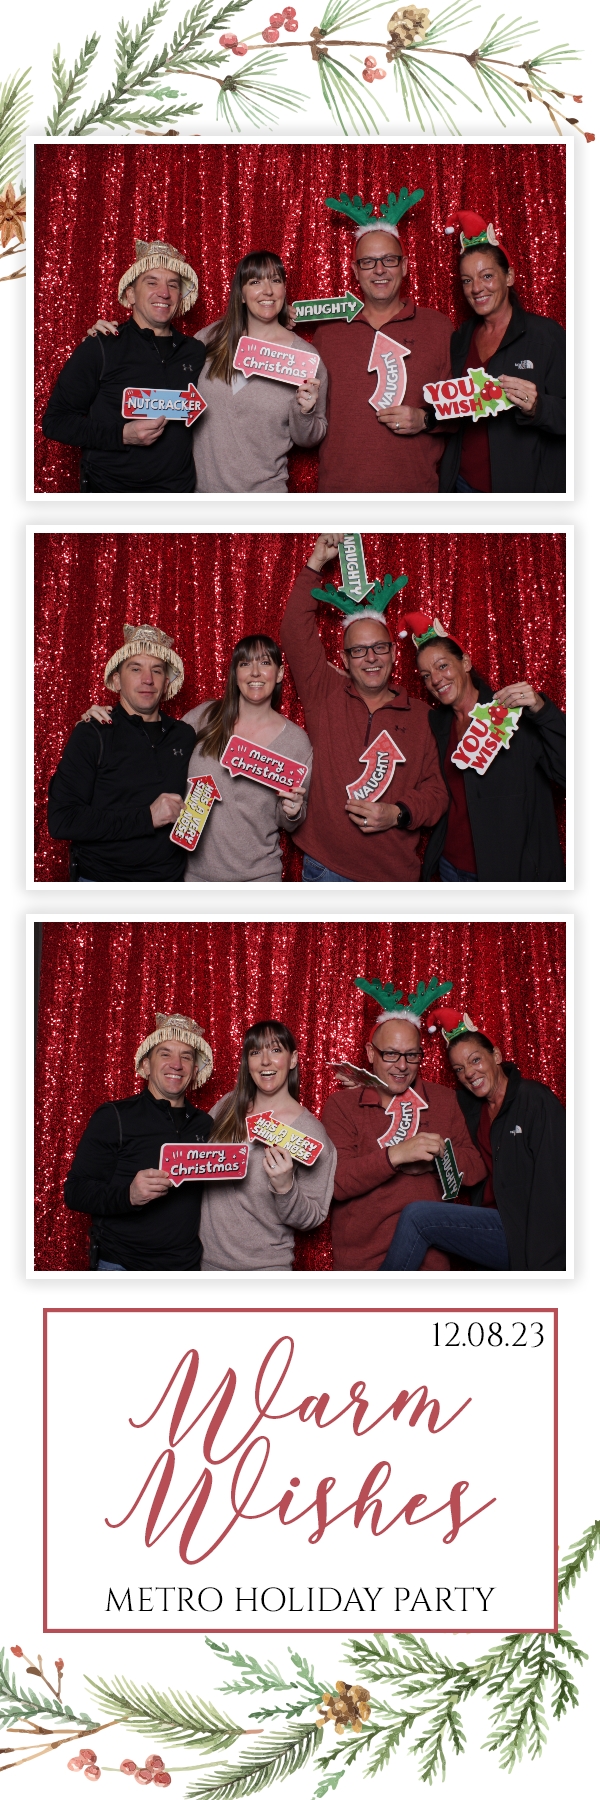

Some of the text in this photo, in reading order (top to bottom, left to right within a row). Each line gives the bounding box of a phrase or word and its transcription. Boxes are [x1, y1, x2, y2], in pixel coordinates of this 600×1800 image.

[295, 301, 357, 317] NAUGHTY
[242, 356, 308, 378] Christmas
[259, 346, 296, 366] Merry
[377, 351, 399, 410] NAUGHTY
[425, 378, 475, 402] YOU
[127, 397, 202, 412] NUTCRACKER
[435, 397, 484, 417] WISH
[343, 535, 362, 595] NAUGHTY
[452, 718, 489, 765] YOU
[470, 726, 506, 769] WISH
[230, 756, 294, 787] Christmas
[248, 749, 285, 773] Merry
[353, 751, 389, 800] NAUGHTY
[175, 780, 205, 839] SHINY NOSE
[185, 783, 215, 845] HAS A VERY
[251, 1125, 312, 1161] SHINY NOSE
[256, 1117, 318, 1152] HAS A VERY
[170, 1160, 239, 1176] Christmas
[186, 1149, 226, 1163] Merry
